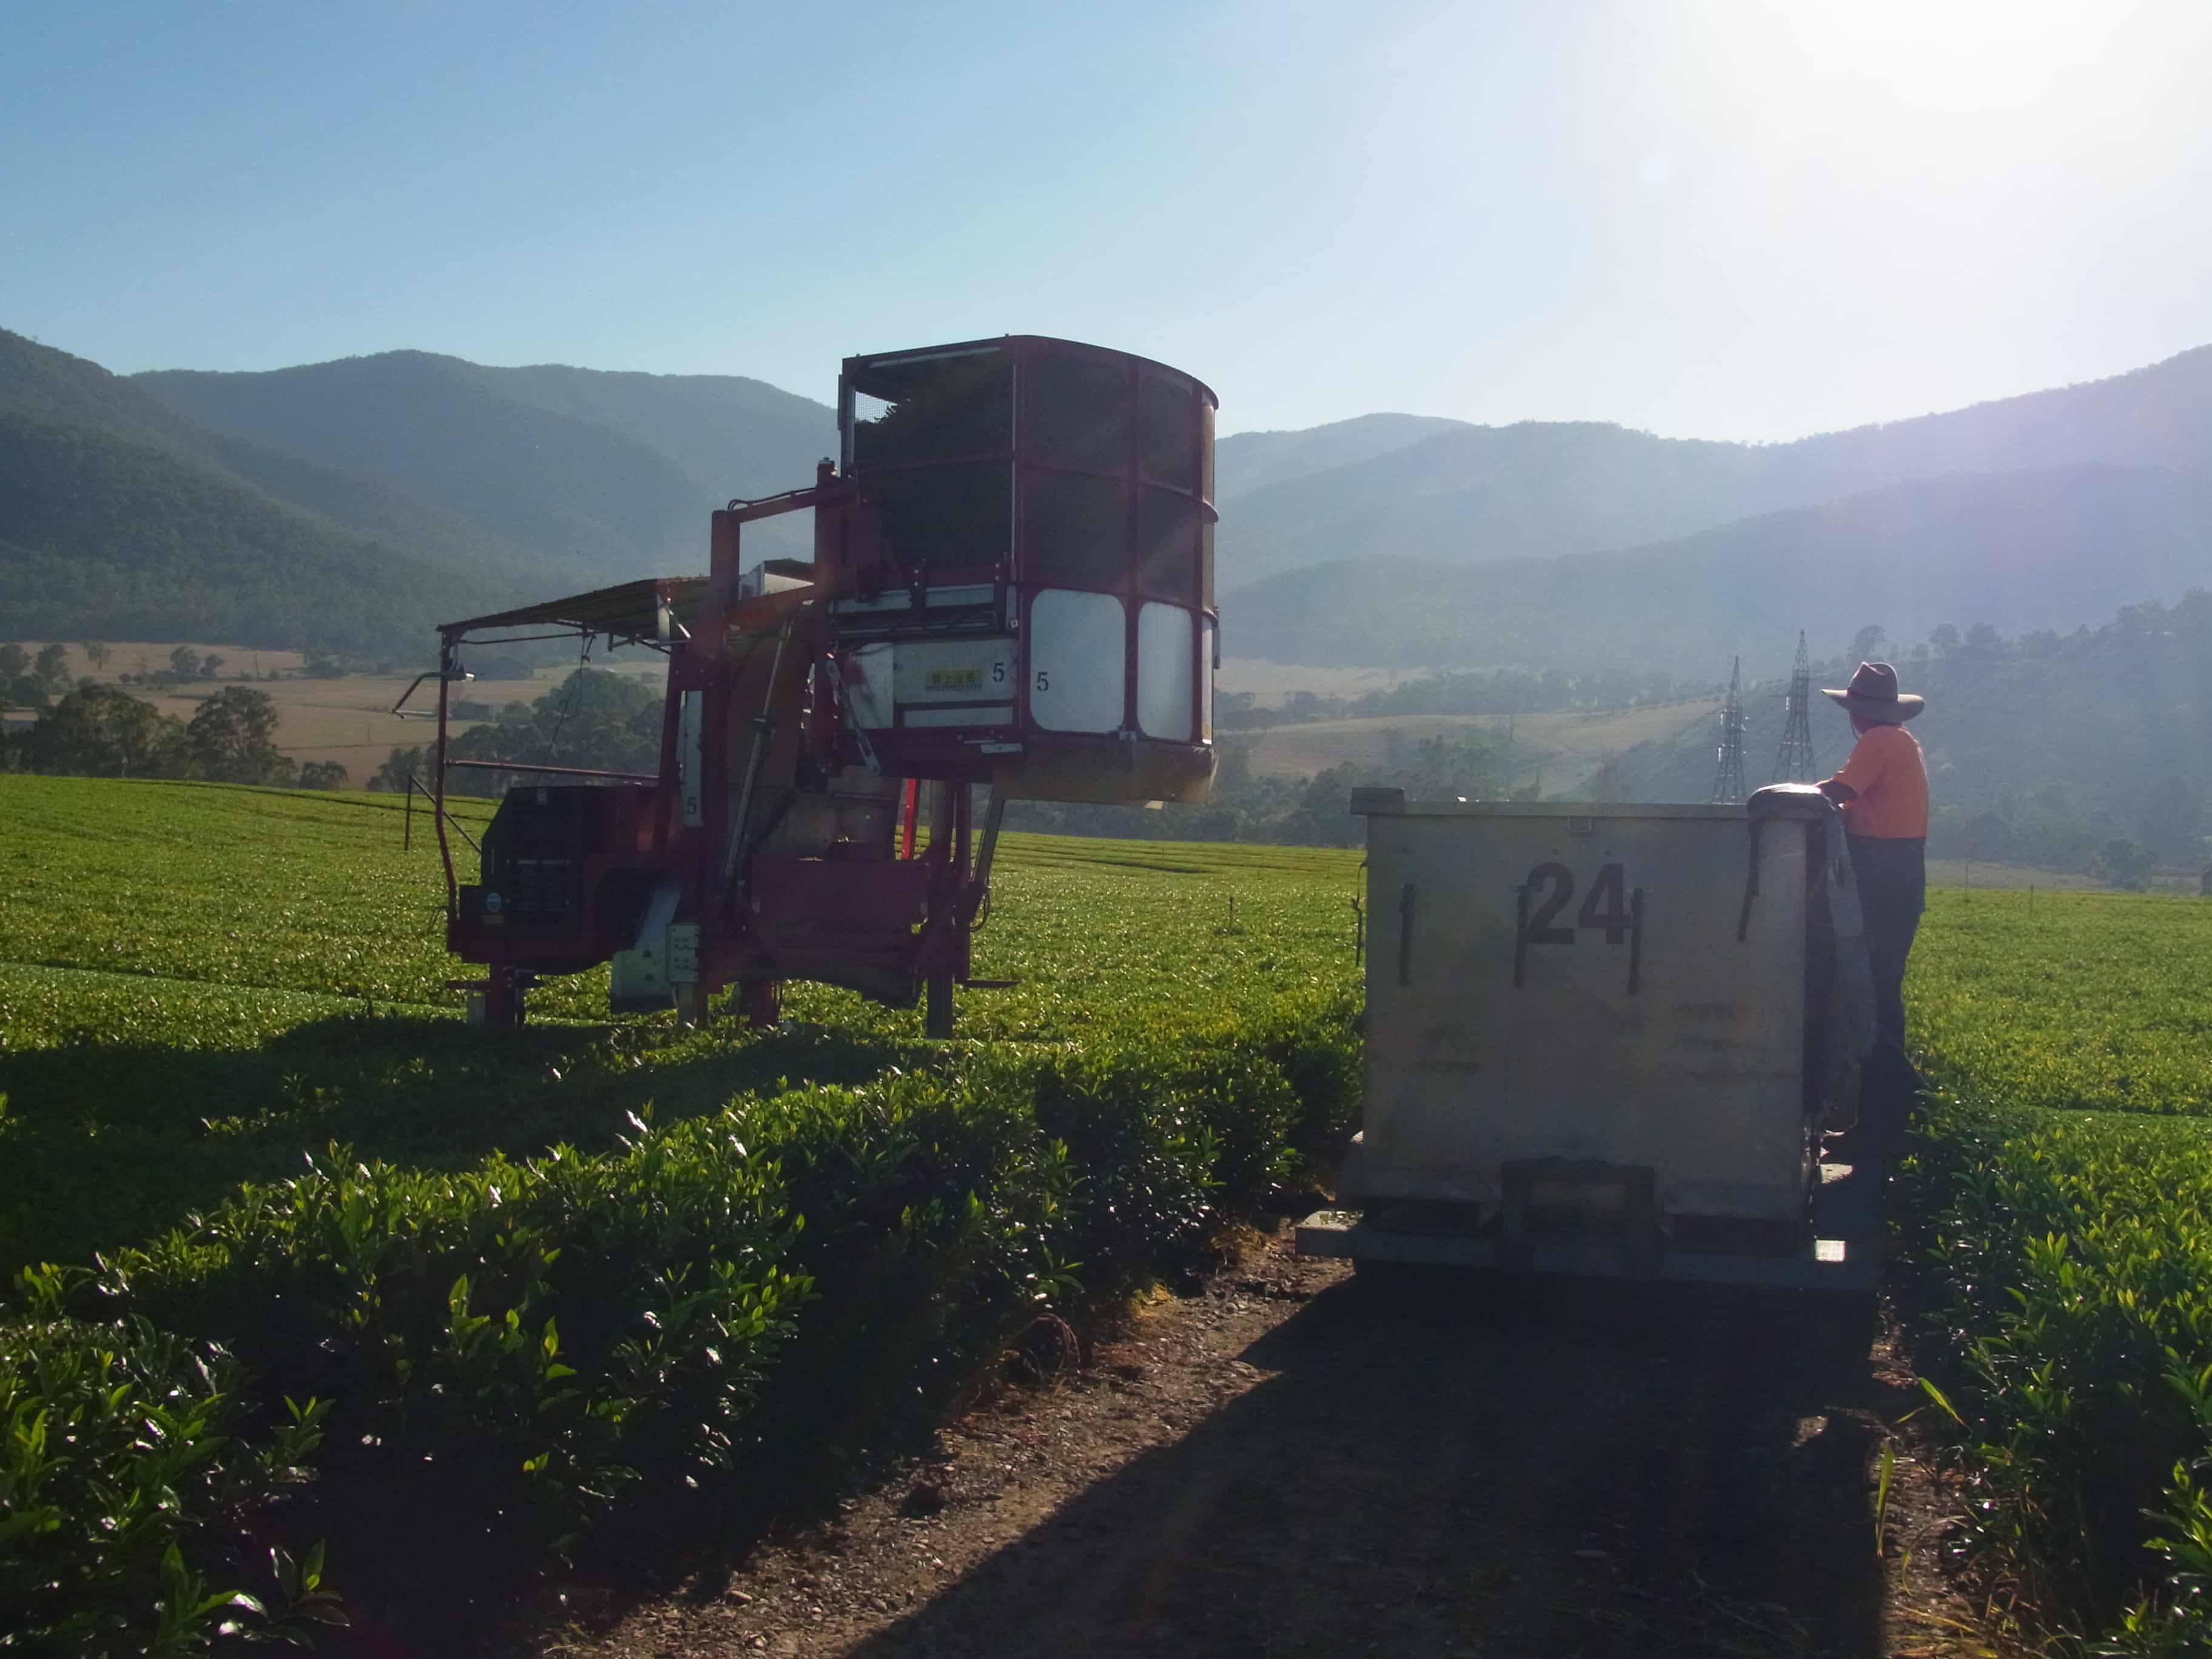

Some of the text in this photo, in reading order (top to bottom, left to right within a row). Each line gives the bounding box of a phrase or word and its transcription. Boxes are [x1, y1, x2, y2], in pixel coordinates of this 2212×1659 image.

[993, 662, 1004, 682] 5
[1037, 672, 1049, 691] 5
[687, 796, 697, 815] 5
[1524, 862, 1631, 944] 24
